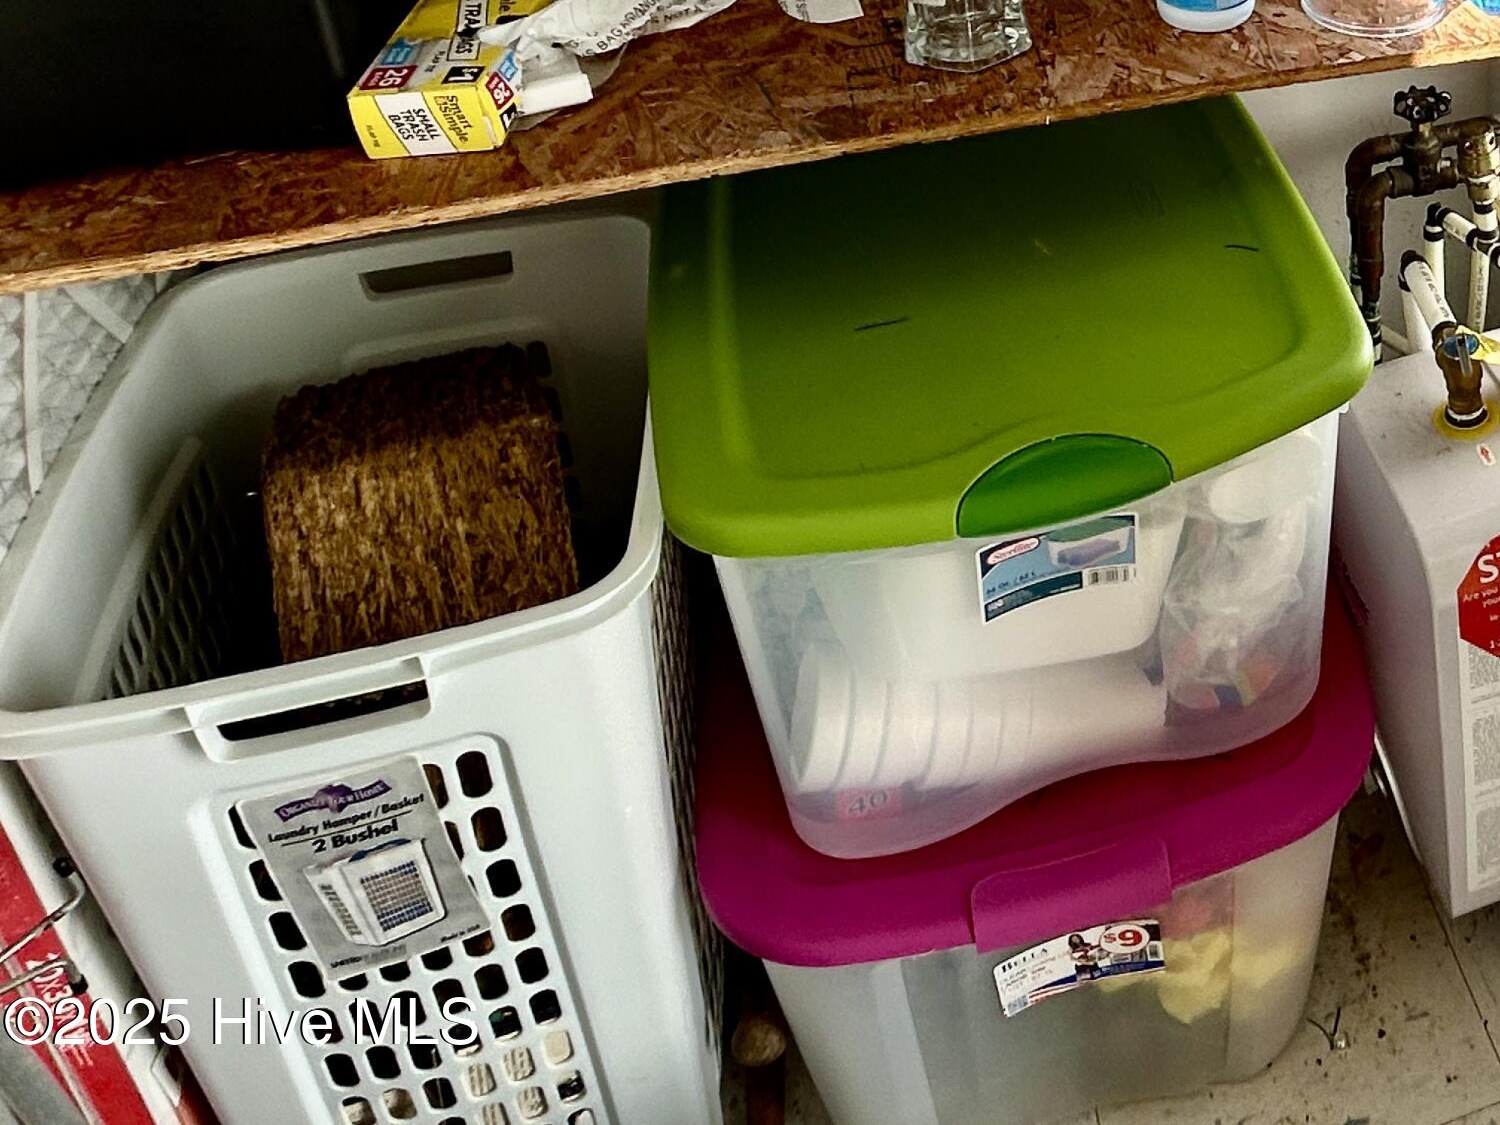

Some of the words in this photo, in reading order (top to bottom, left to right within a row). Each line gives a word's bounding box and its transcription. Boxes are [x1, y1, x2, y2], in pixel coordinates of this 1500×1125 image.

[597, 28, 623, 52] BAG
[380, 68, 408, 87] 26
[493, 83, 511, 105] 26
[412, 109, 442, 140] SMALL
[447, 96, 472, 129] Smart
[388, 114, 414, 140] BAGS
[400, 109, 429, 142] TRASH
[1463, 592, 1480, 603] Are
[1481, 586, 1499, 598] you
[268, 822, 320, 844] Laundry
[311, 838, 327, 854] 2
[331, 819, 399, 850] Bushel
[1103, 929, 1144, 947] $9
